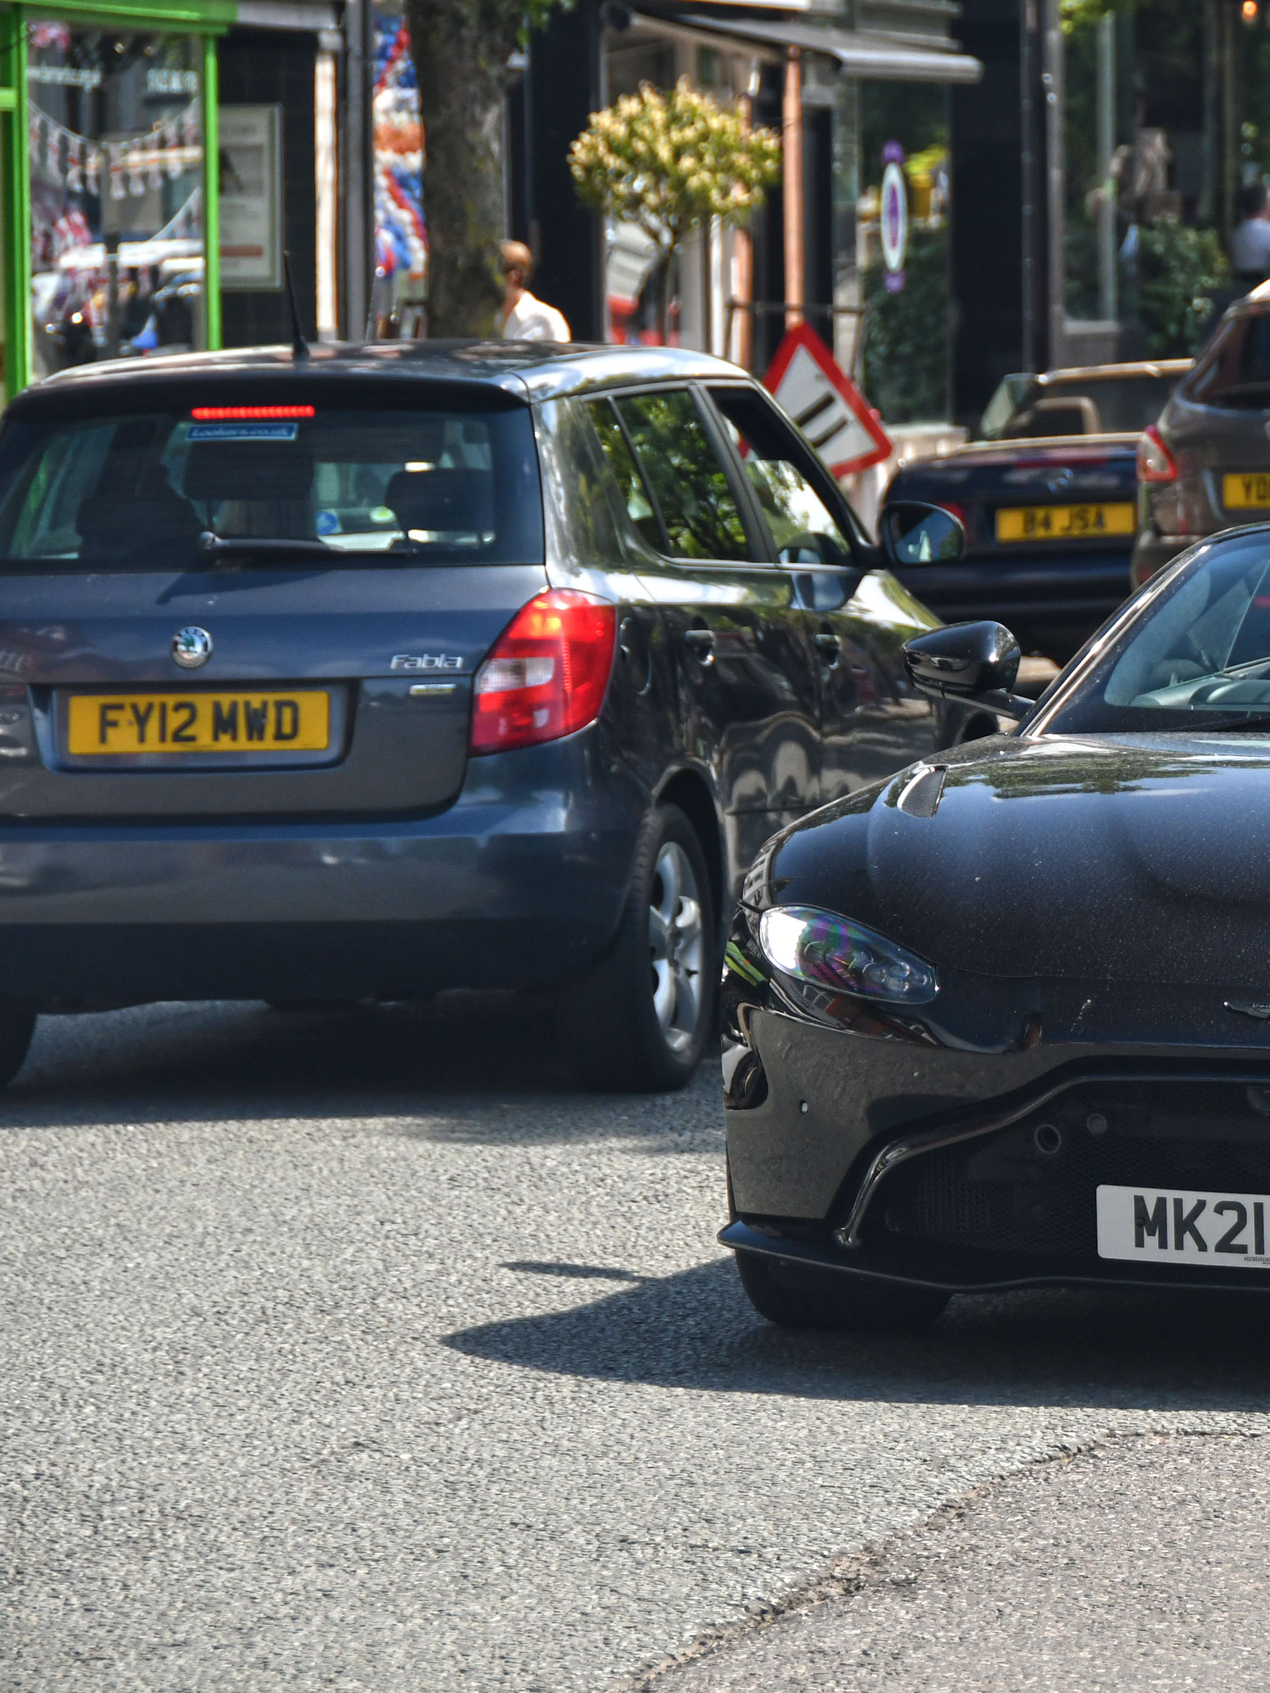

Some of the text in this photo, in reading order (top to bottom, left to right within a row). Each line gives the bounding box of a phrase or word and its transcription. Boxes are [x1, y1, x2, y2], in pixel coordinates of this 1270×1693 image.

[390, 653, 463, 669] Fabia
[98, 699, 300, 744] FY12 MWD
[1133, 1195, 1265, 1255] MK21
